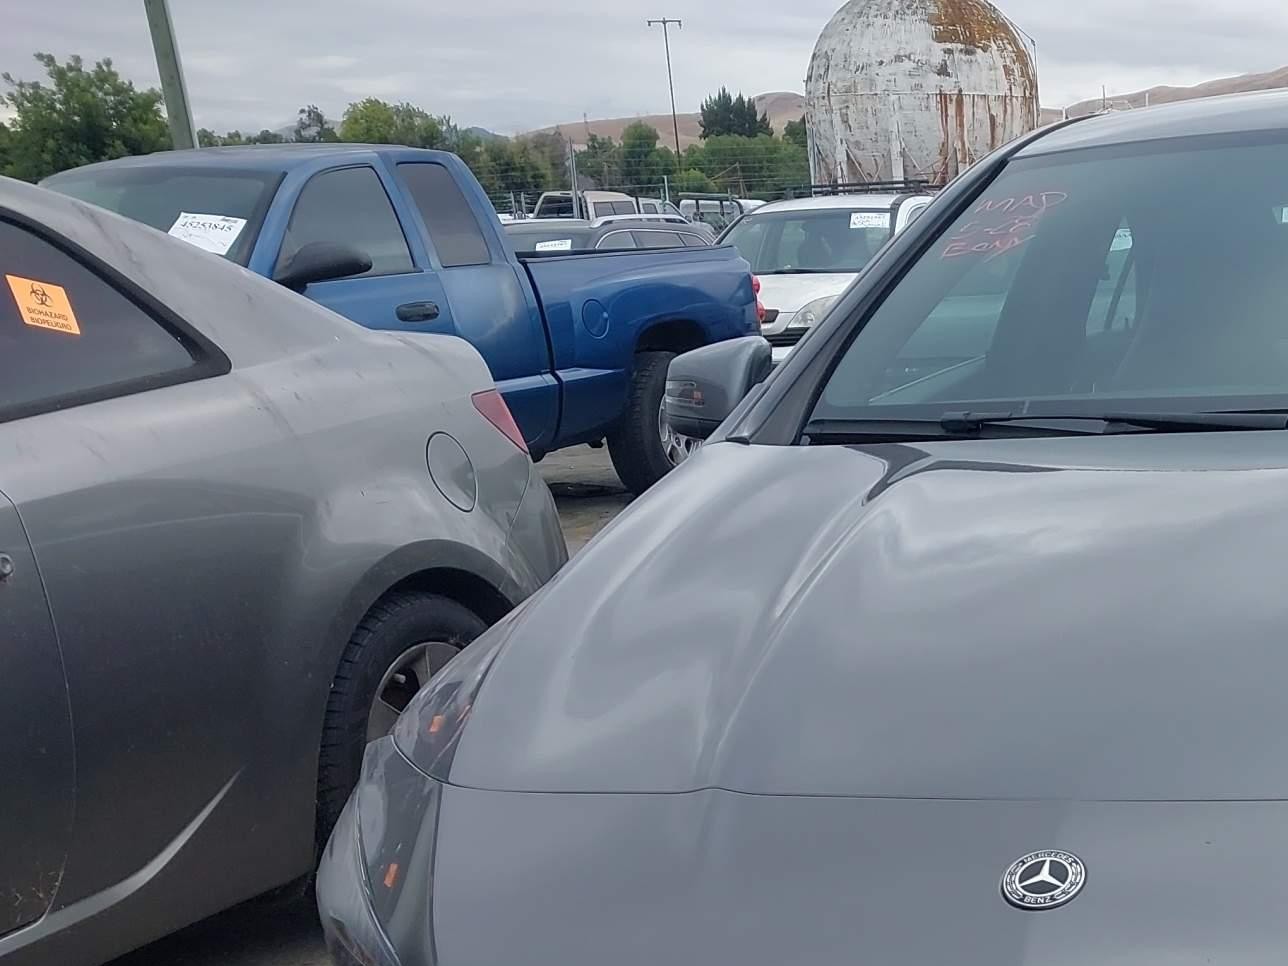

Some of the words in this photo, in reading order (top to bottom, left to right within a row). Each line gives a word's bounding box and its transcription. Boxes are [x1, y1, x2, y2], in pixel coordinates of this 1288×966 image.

[26, 306, 68, 321] BIOHAZARD
[30, 316, 72, 330] BIOPELIGRO
[1023, 851, 1075, 863] MERCEDES
[1023, 896, 1053, 904] BENZ
